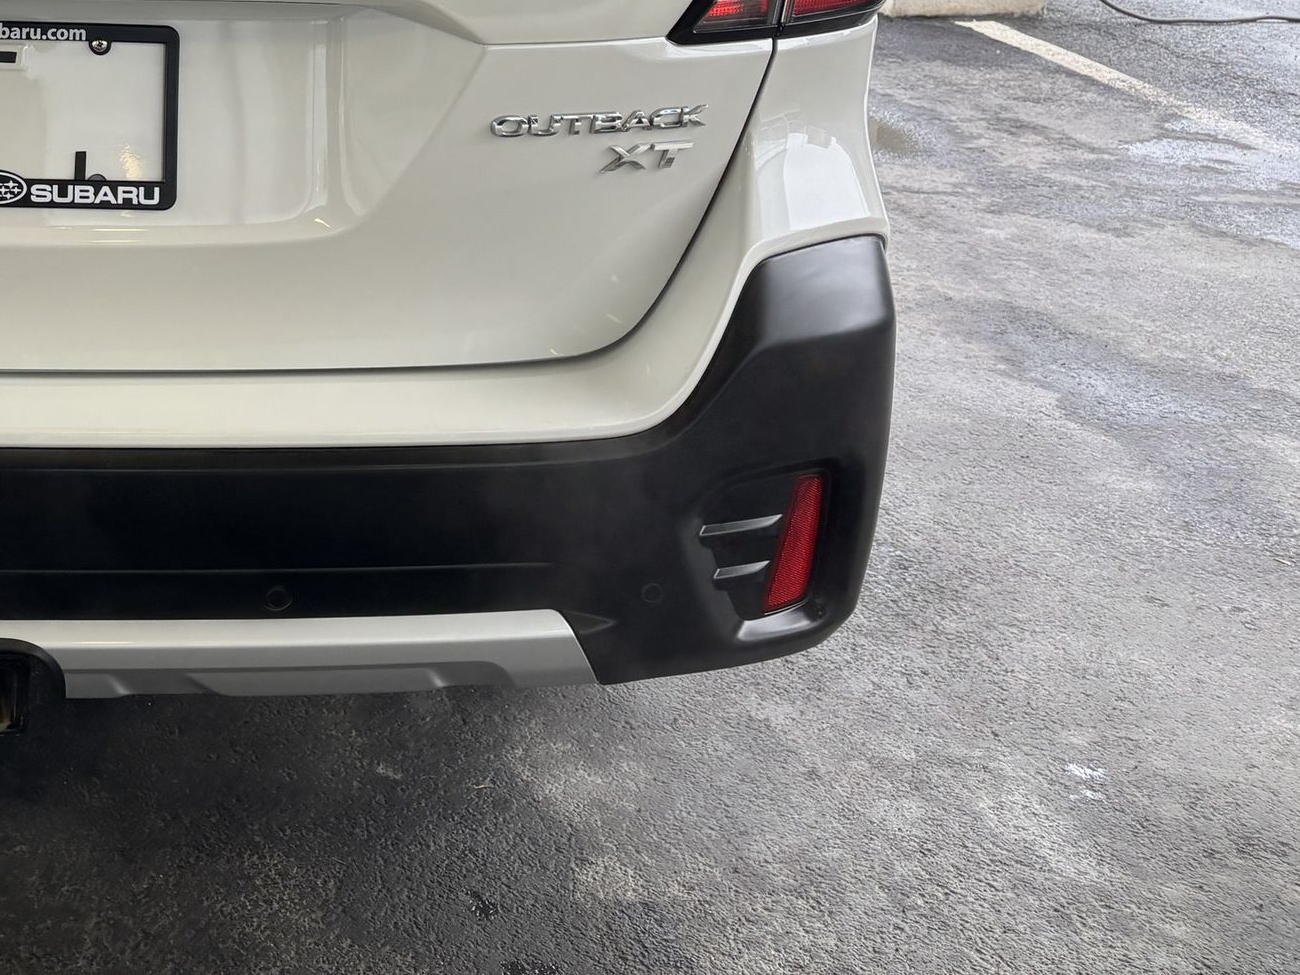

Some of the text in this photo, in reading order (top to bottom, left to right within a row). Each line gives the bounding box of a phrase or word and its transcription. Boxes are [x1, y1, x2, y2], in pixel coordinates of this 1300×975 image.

[490, 104, 709, 137] OUTBACK
[599, 140, 694, 174] XT
[29, 183, 161, 206] SUBARU
